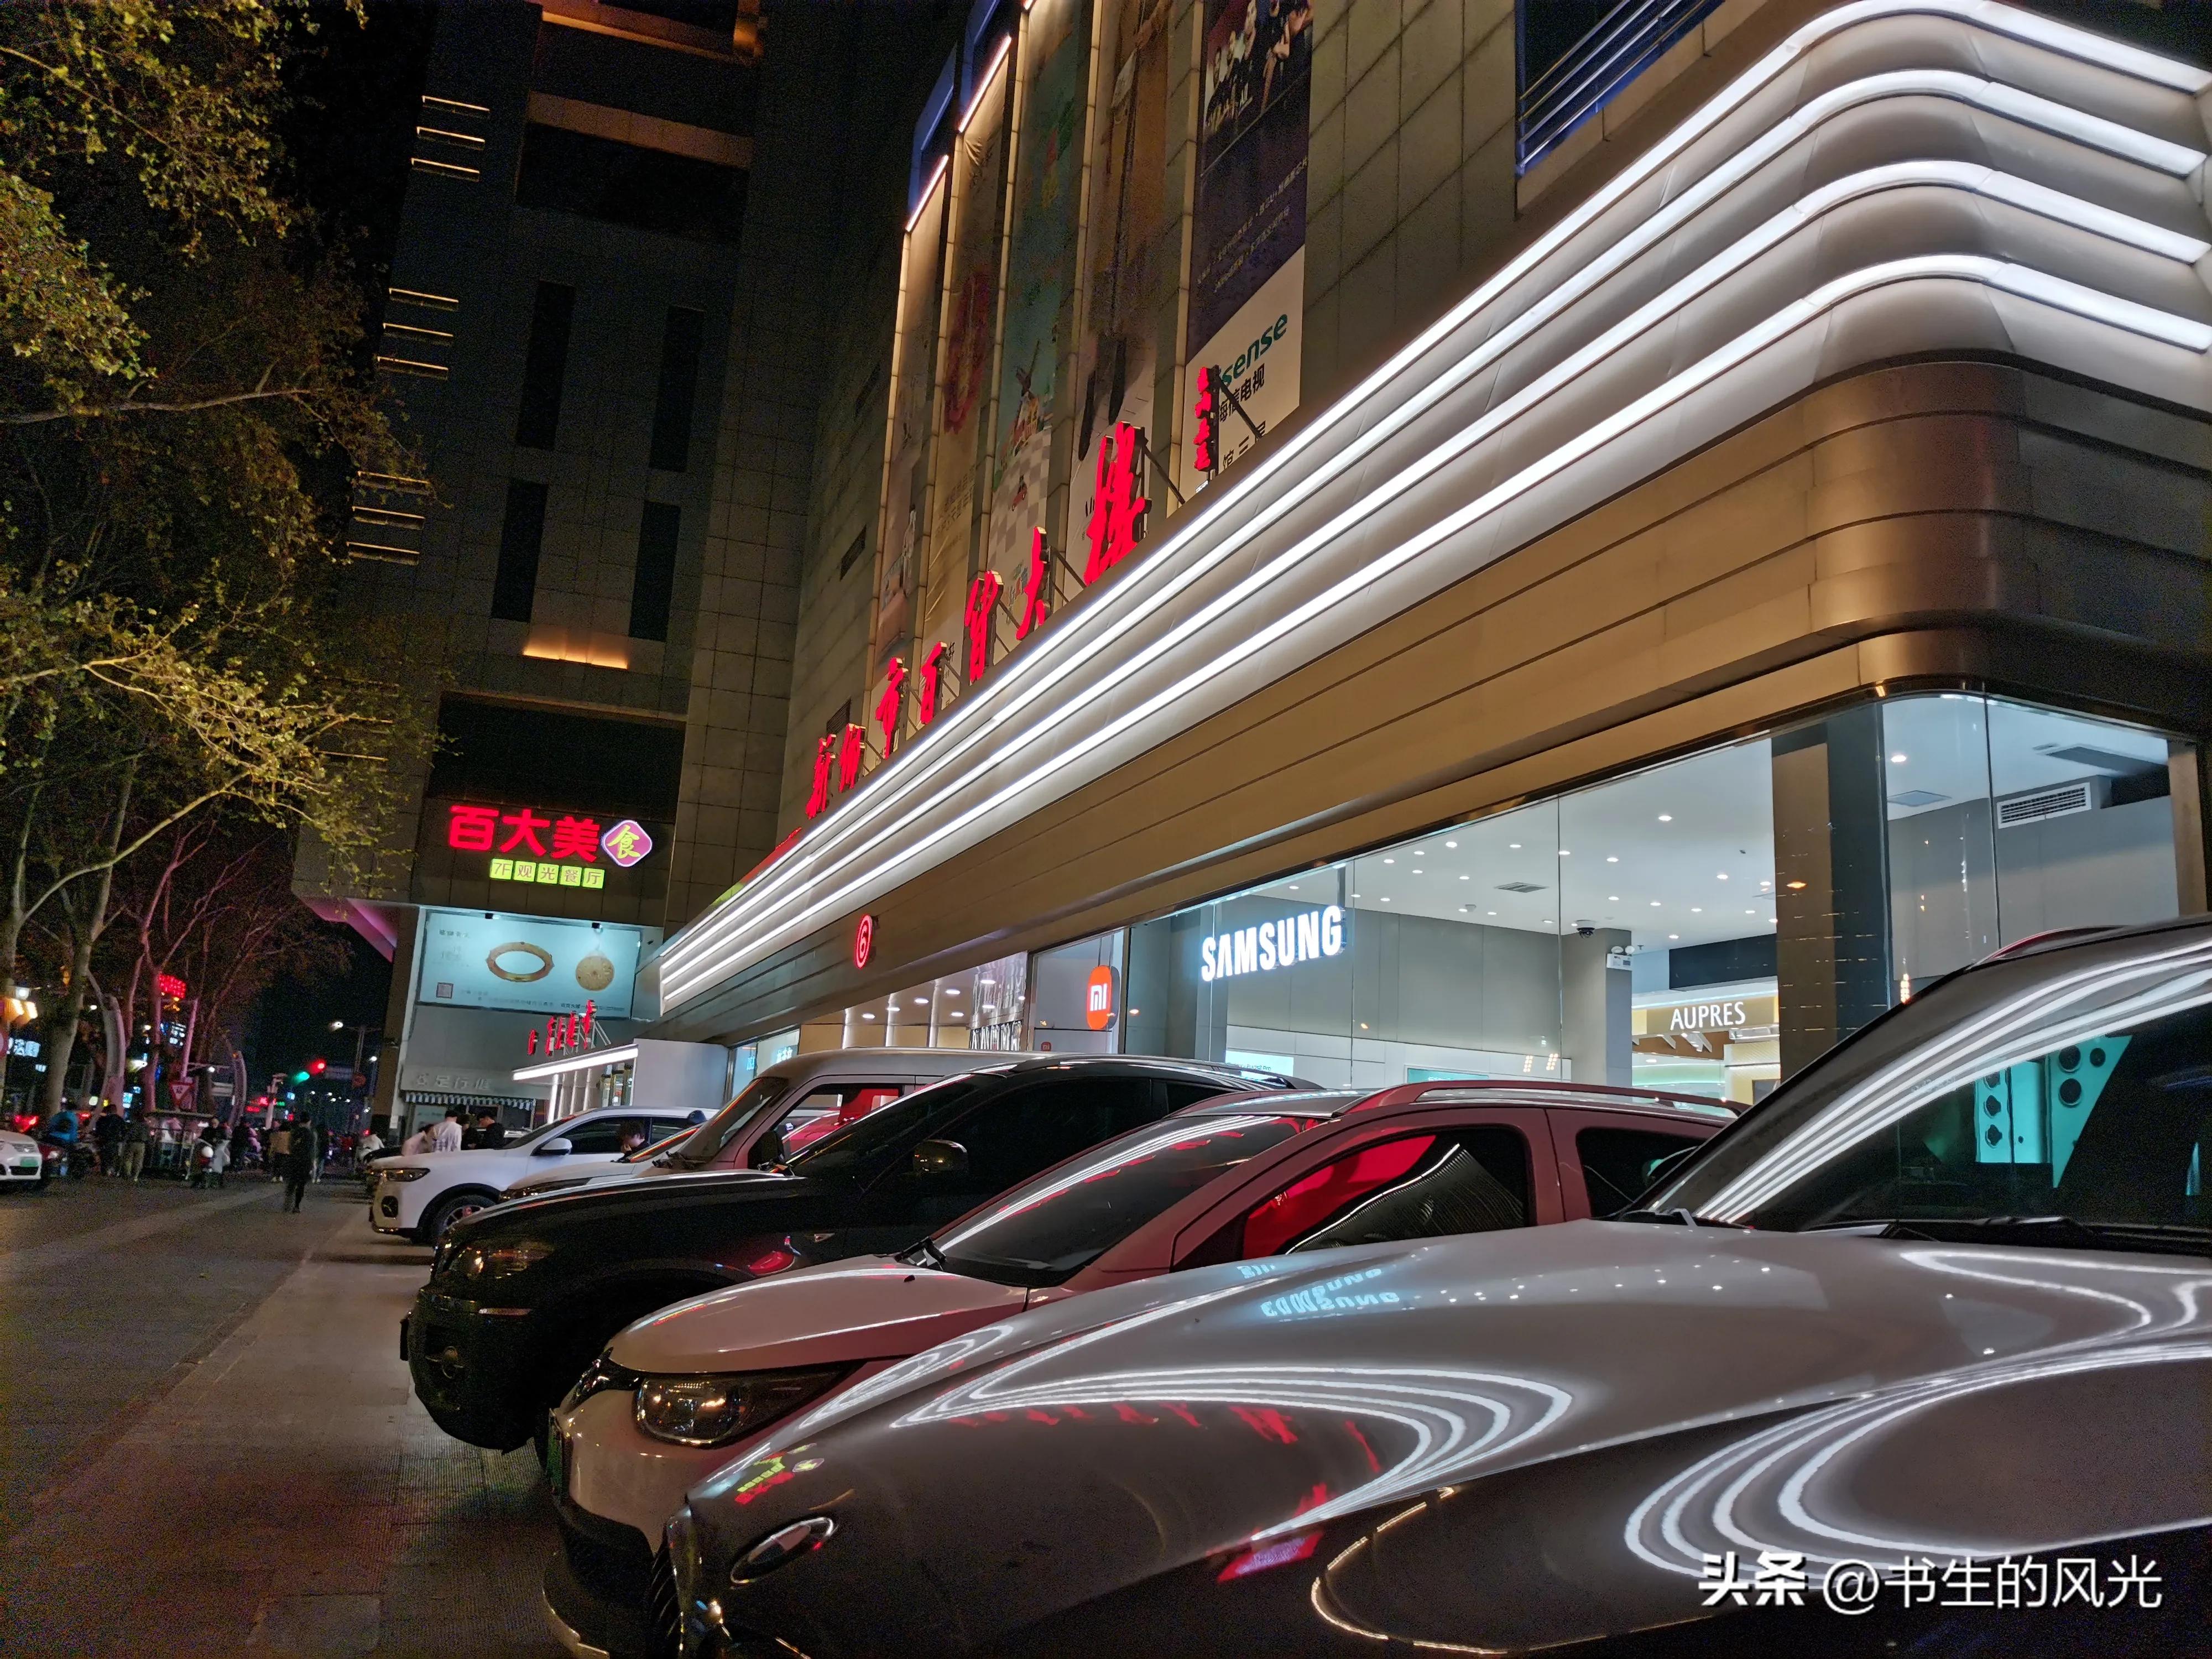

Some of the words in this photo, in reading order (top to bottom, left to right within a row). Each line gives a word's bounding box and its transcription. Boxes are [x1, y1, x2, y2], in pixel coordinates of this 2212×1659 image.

[1221, 314, 1288, 387] sense
[449, 805, 641, 863] 百大美食
[493, 862, 601, 885] 7F观光餐厅
[1201, 905, 1344, 982] SAMSUNG
[1670, 1001, 1746, 1031] AUPRES
